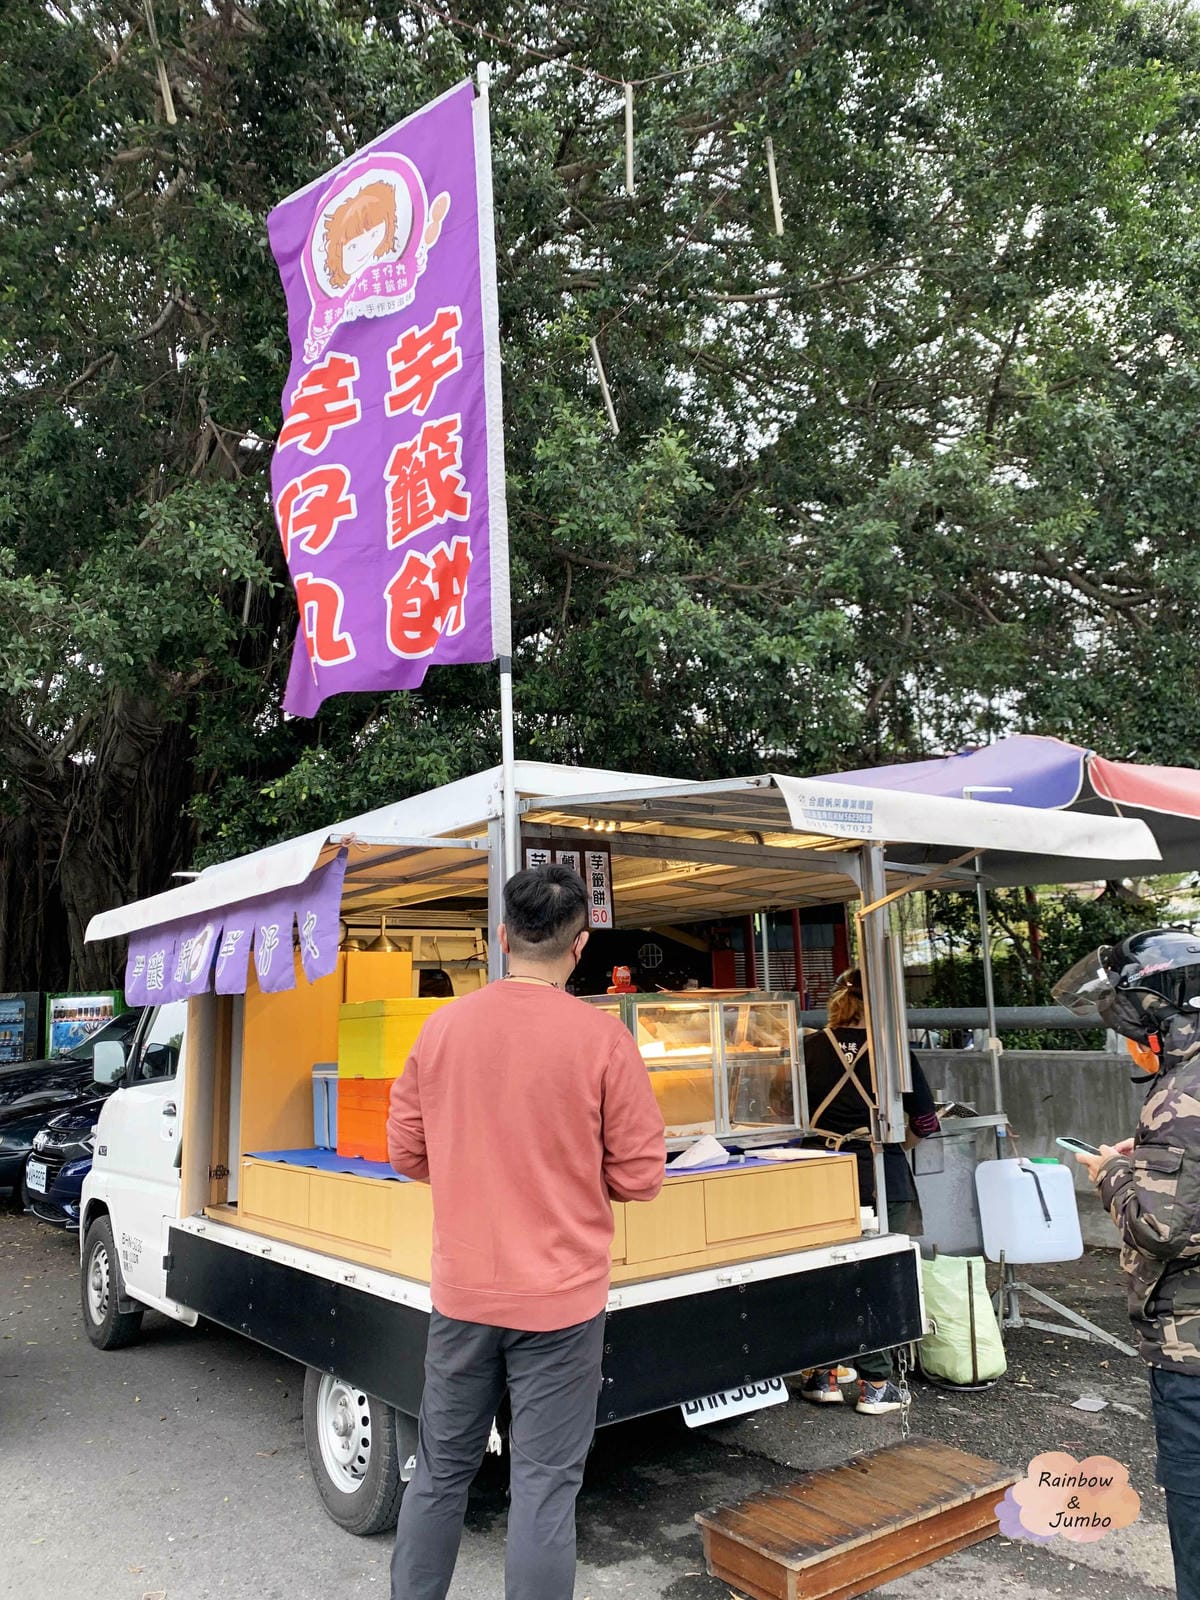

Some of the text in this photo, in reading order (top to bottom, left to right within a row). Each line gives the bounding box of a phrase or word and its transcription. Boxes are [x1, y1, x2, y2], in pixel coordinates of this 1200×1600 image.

[384, 305, 472, 660] 芋籤餅
[592, 909, 608, 923] 50
